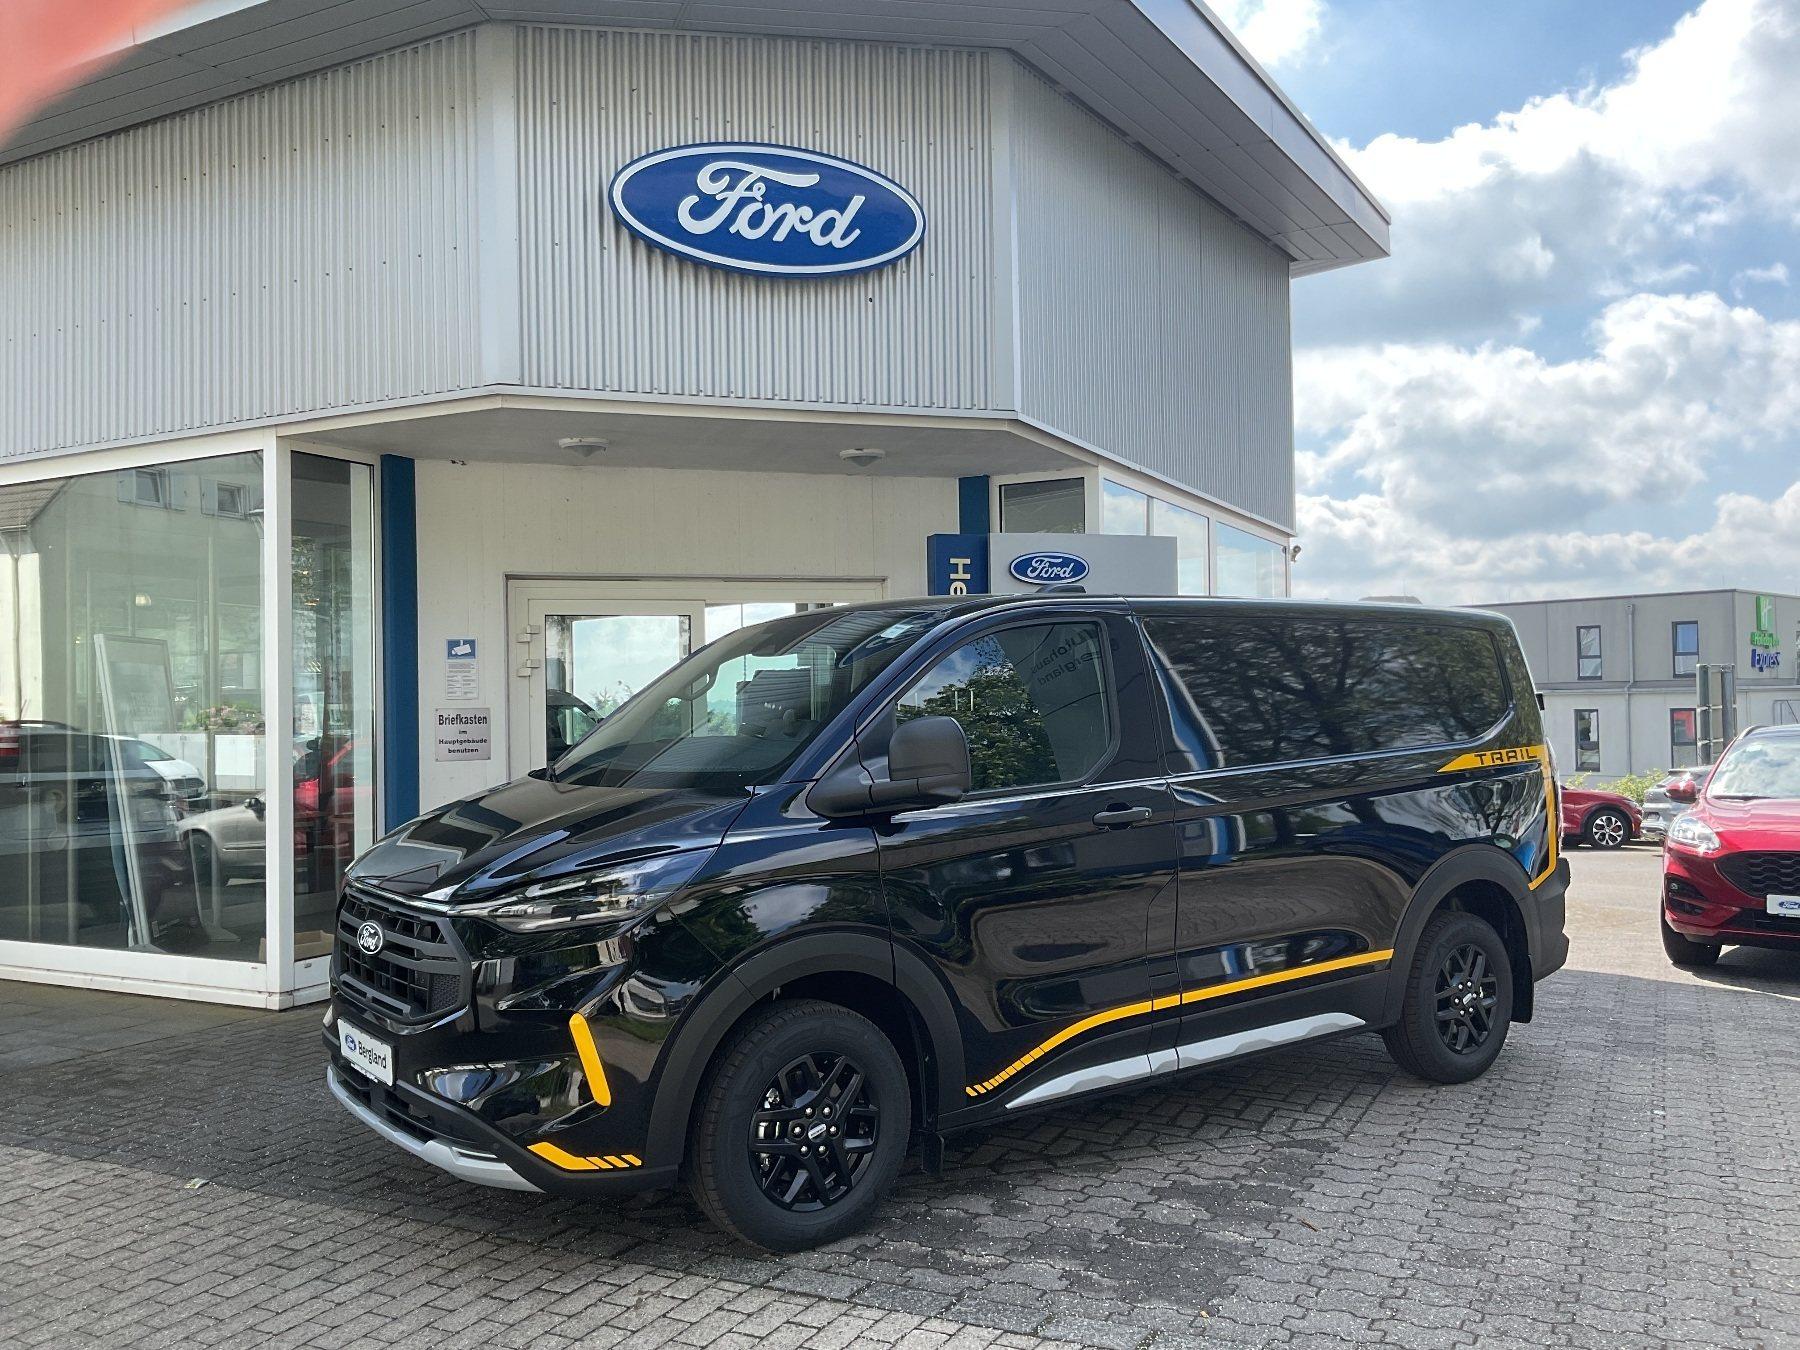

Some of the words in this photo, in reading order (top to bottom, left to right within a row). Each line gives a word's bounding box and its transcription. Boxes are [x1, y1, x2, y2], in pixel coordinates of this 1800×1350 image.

[677, 161, 866, 249] Ford
[1027, 556, 1075, 579] Ford
[438, 714, 488, 725] Briefkasten
[438, 738, 488, 746] Hauptgebäude
[1474, 748, 1537, 766] TRAIL
[360, 925, 379, 951] Ford
[358, 1041, 387, 1069] Bergland
